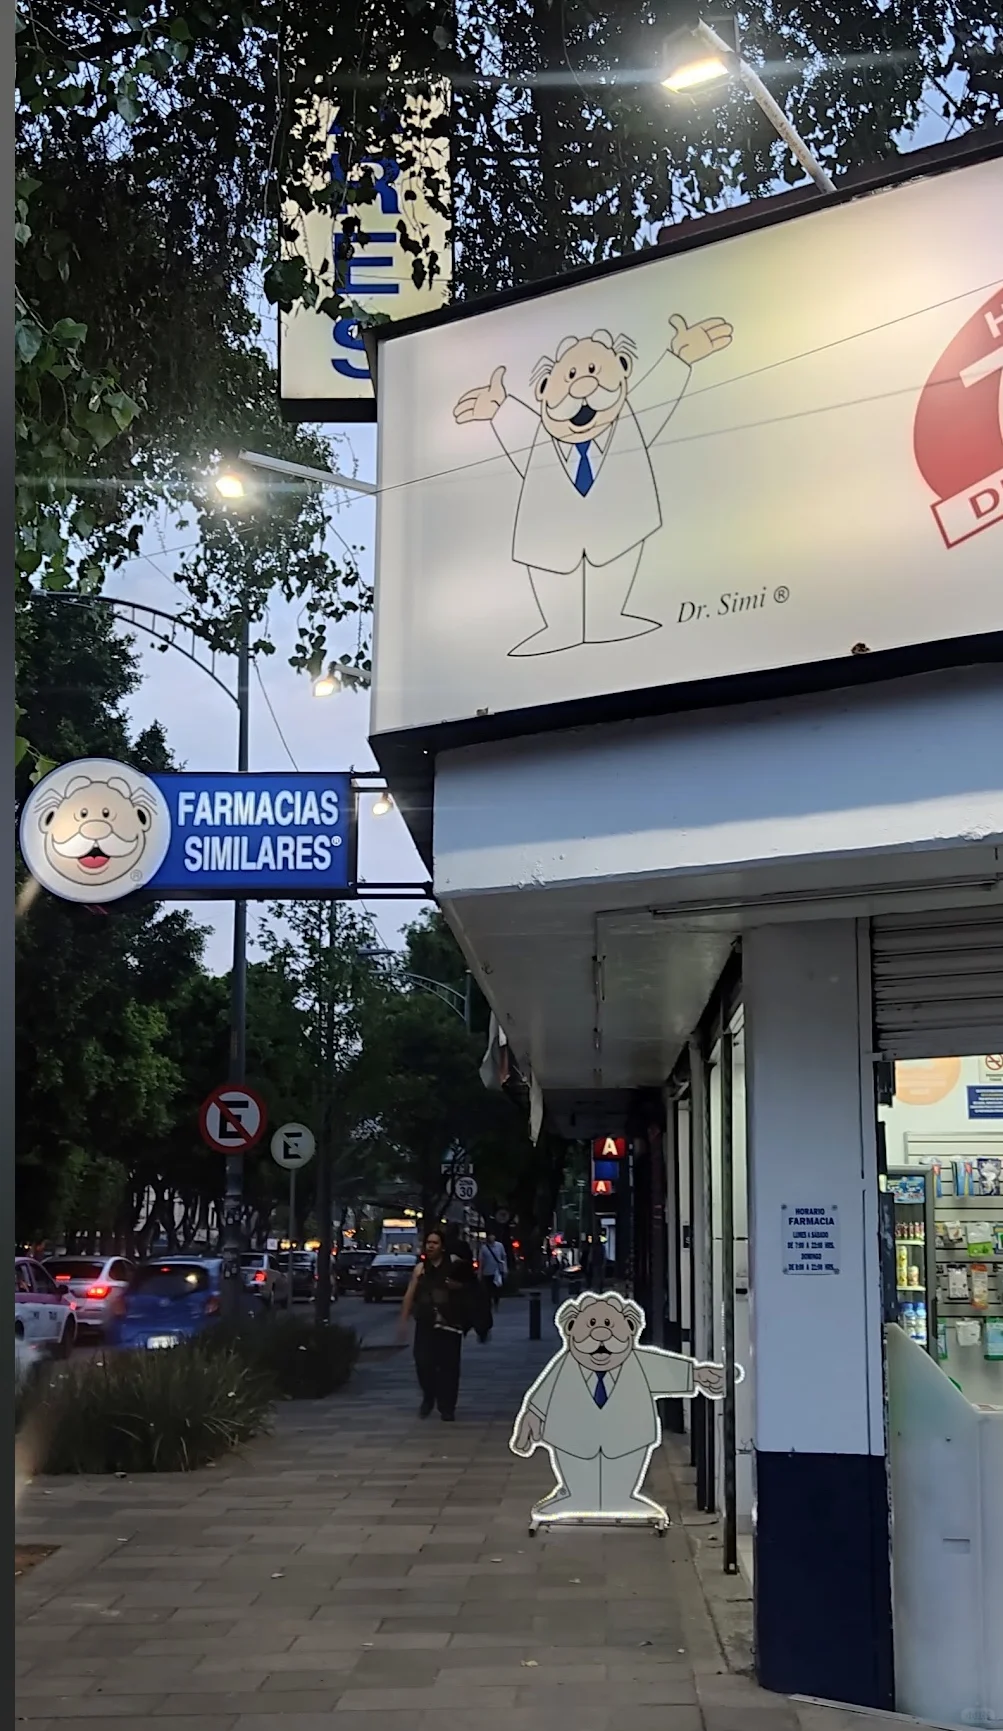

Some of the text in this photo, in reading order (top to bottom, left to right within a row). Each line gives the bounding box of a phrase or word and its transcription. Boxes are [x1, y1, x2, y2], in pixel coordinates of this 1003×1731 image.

[677, 601, 710, 623] Dr.
[717, 586, 767, 615] Simi
[177, 790, 339, 826] FARMACIAS
[602, 1137, 619, 1156] A
[459, 1186, 473, 1198] 30
[788, 1217, 835, 1225] FARMACIA
